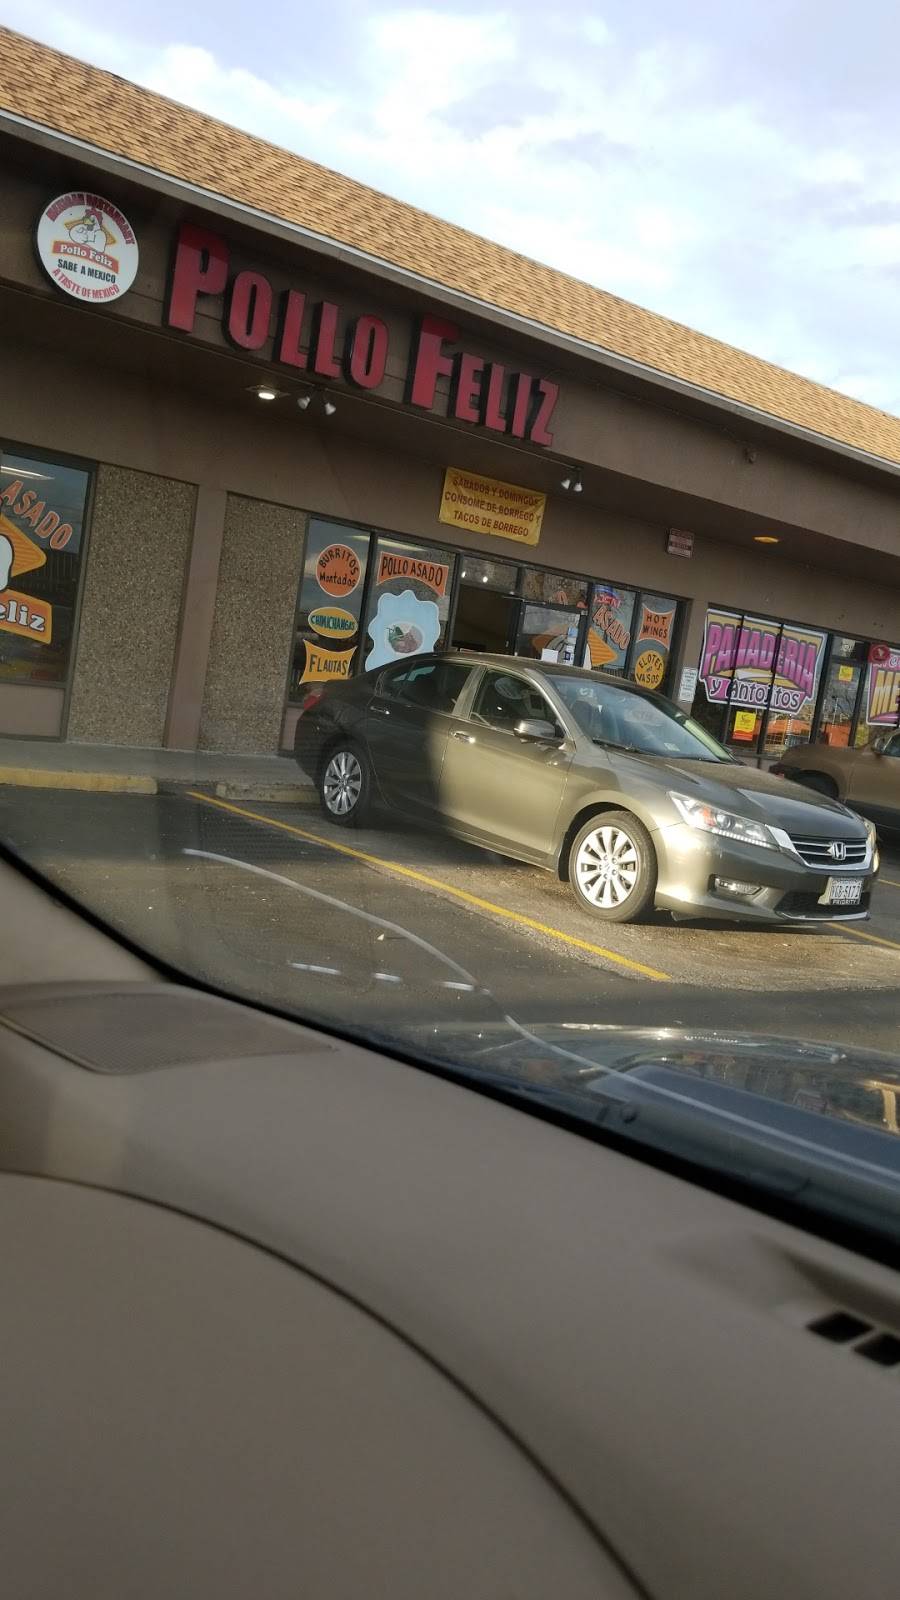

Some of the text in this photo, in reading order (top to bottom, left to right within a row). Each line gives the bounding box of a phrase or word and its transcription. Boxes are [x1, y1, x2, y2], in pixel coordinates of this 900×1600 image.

[60, 244, 113, 268] Pollo Feliz
[52, 268, 120, 299] A TASTE OF MEXICO
[58, 258, 116, 284] SABE A MEXICO
[167, 222, 560, 447] POLLO FELIZ
[492, 487, 497, 497] Y
[0, 480, 73, 550] ASADO
[444, 491, 485, 510] CONSOME
[487, 502, 497, 513] DE
[498, 505, 534, 522] BORREGO
[454, 510, 529, 537] TACOS DE BORREGO
[319, 547, 360, 576] BURRITOS
[381, 556, 443, 587] POLLO ASADO
[320, 571, 356, 588] Montados
[311, 614, 355, 631] CHIMICHANGAS
[593, 605, 631, 651] ASADO
[642, 625, 668, 639] WINGS
[646, 614, 667, 625] HOT
[309, 654, 348, 676] FLAUTAS
[639, 654, 662, 671] ELOTES
[636, 673, 659, 684] VASOS
[710, 678, 722, 695] y
[729, 680, 800, 709] Antojtos
